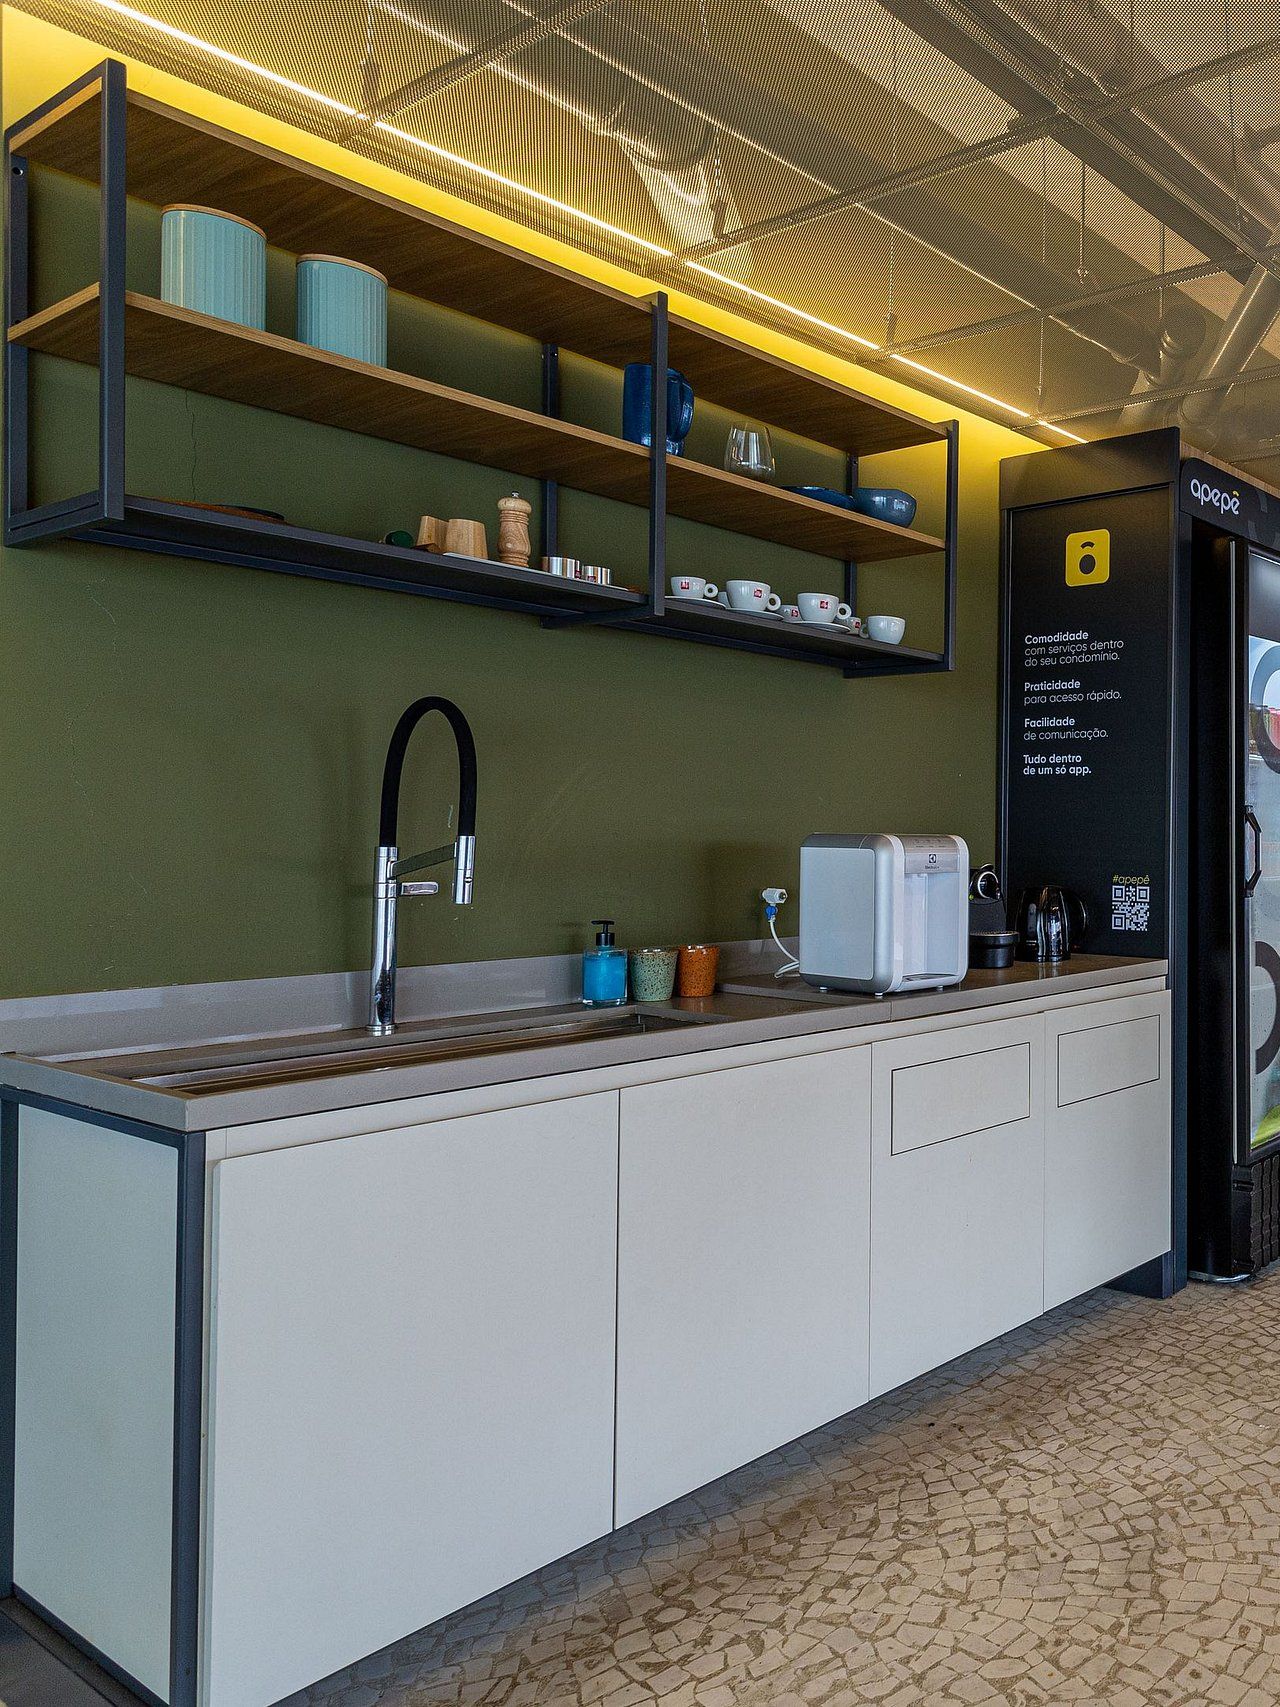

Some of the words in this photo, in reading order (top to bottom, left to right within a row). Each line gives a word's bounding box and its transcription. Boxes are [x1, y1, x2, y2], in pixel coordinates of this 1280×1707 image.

[1190, 478, 1240, 515] apepê
[1024, 630, 1089, 645] Comodidade
[1024, 646, 1046, 656] com
[1048, 643, 1088, 655] serviços
[1089, 640, 1124, 651] dentro
[1024, 657, 1038, 667] do
[1040, 657, 1057, 666] seu
[1059, 650, 1120, 665] condomínio.
[1024, 679, 1081, 692] Praticidade
[1024, 695, 1047, 706] para
[1049, 693, 1084, 703] acesso
[1086, 690, 1122, 702] rápido.
[1024, 716, 1076, 728] Facilidade
[1023, 731, 1037, 740] de
[1038, 728, 1109, 740] comunicação.
[1023, 754, 1047, 764] Tudo
[1049, 754, 1082, 763] dentro
[1023, 766, 1036, 775] de
[1038, 766, 1053, 775] um
[1055, 764, 1067, 774] só
[1069, 765, 1092, 777] app.
[1112, 874, 1150, 886] #apepê
